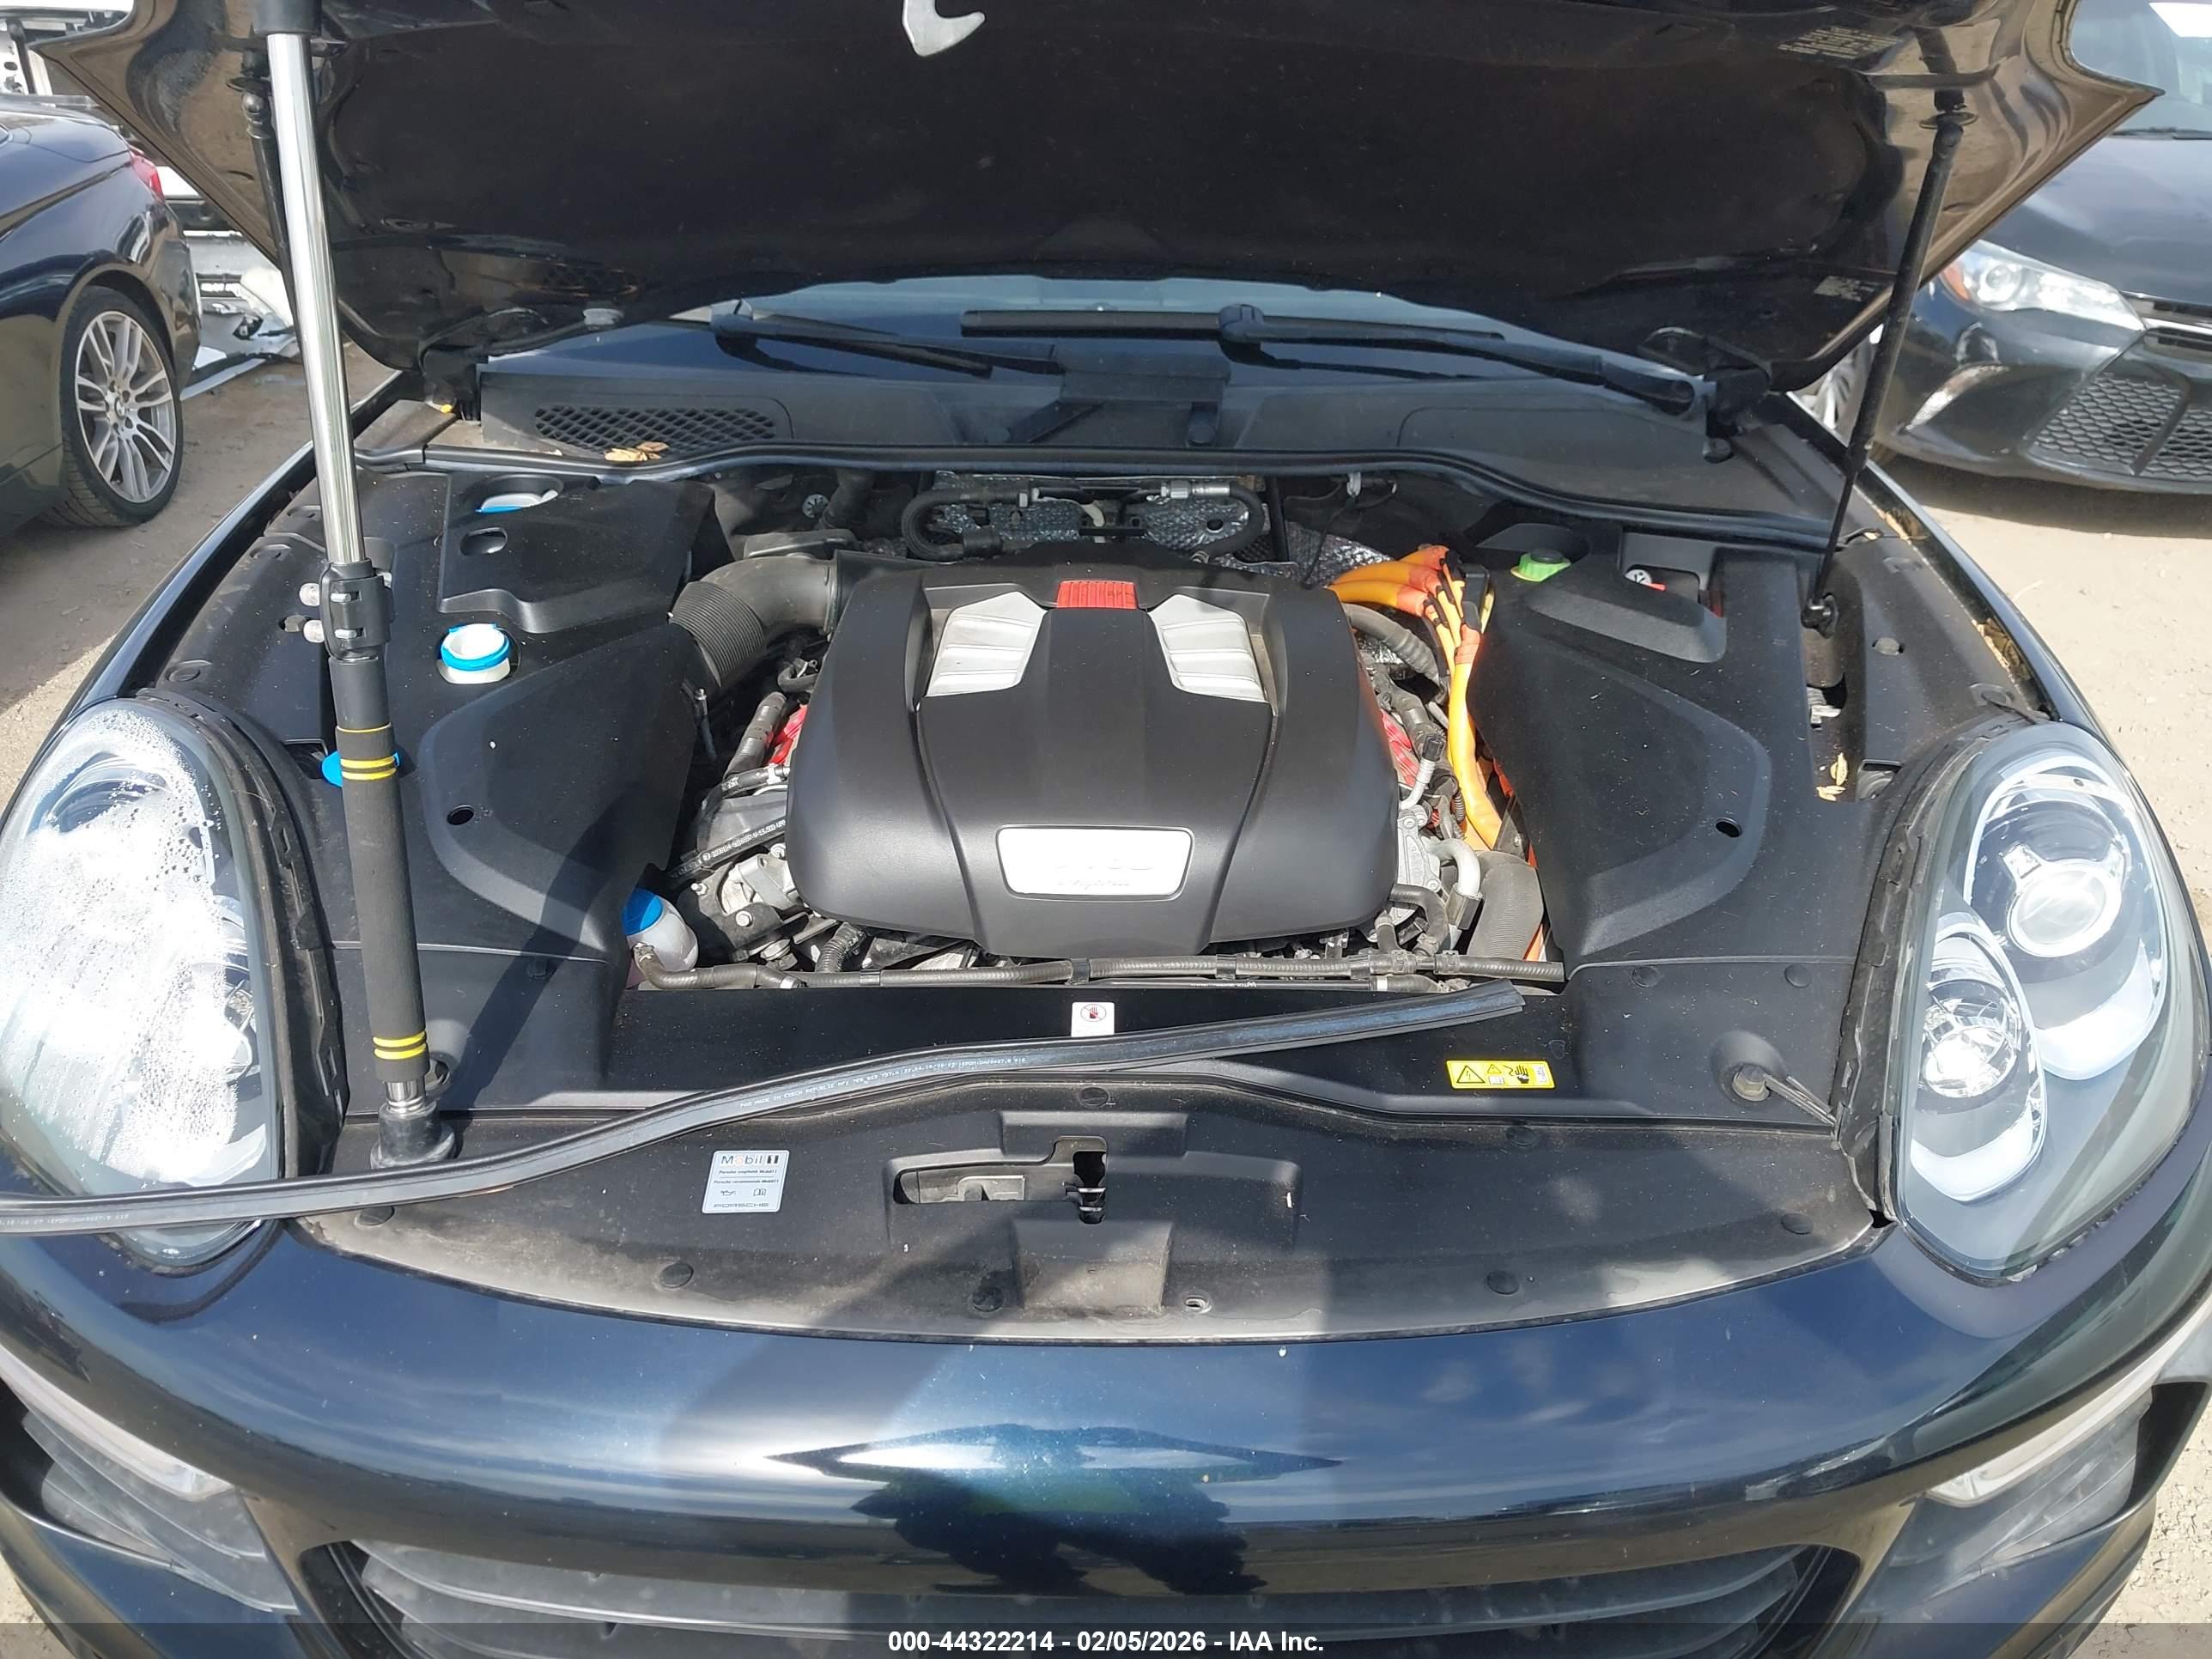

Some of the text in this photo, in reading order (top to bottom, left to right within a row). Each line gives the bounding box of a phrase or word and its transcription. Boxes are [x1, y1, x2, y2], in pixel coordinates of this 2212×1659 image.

[783, 1090, 803, 1099] CZECH
[805, 1082, 835, 1094] REPUBLIC
[720, 1155, 763, 1164] Mobil
